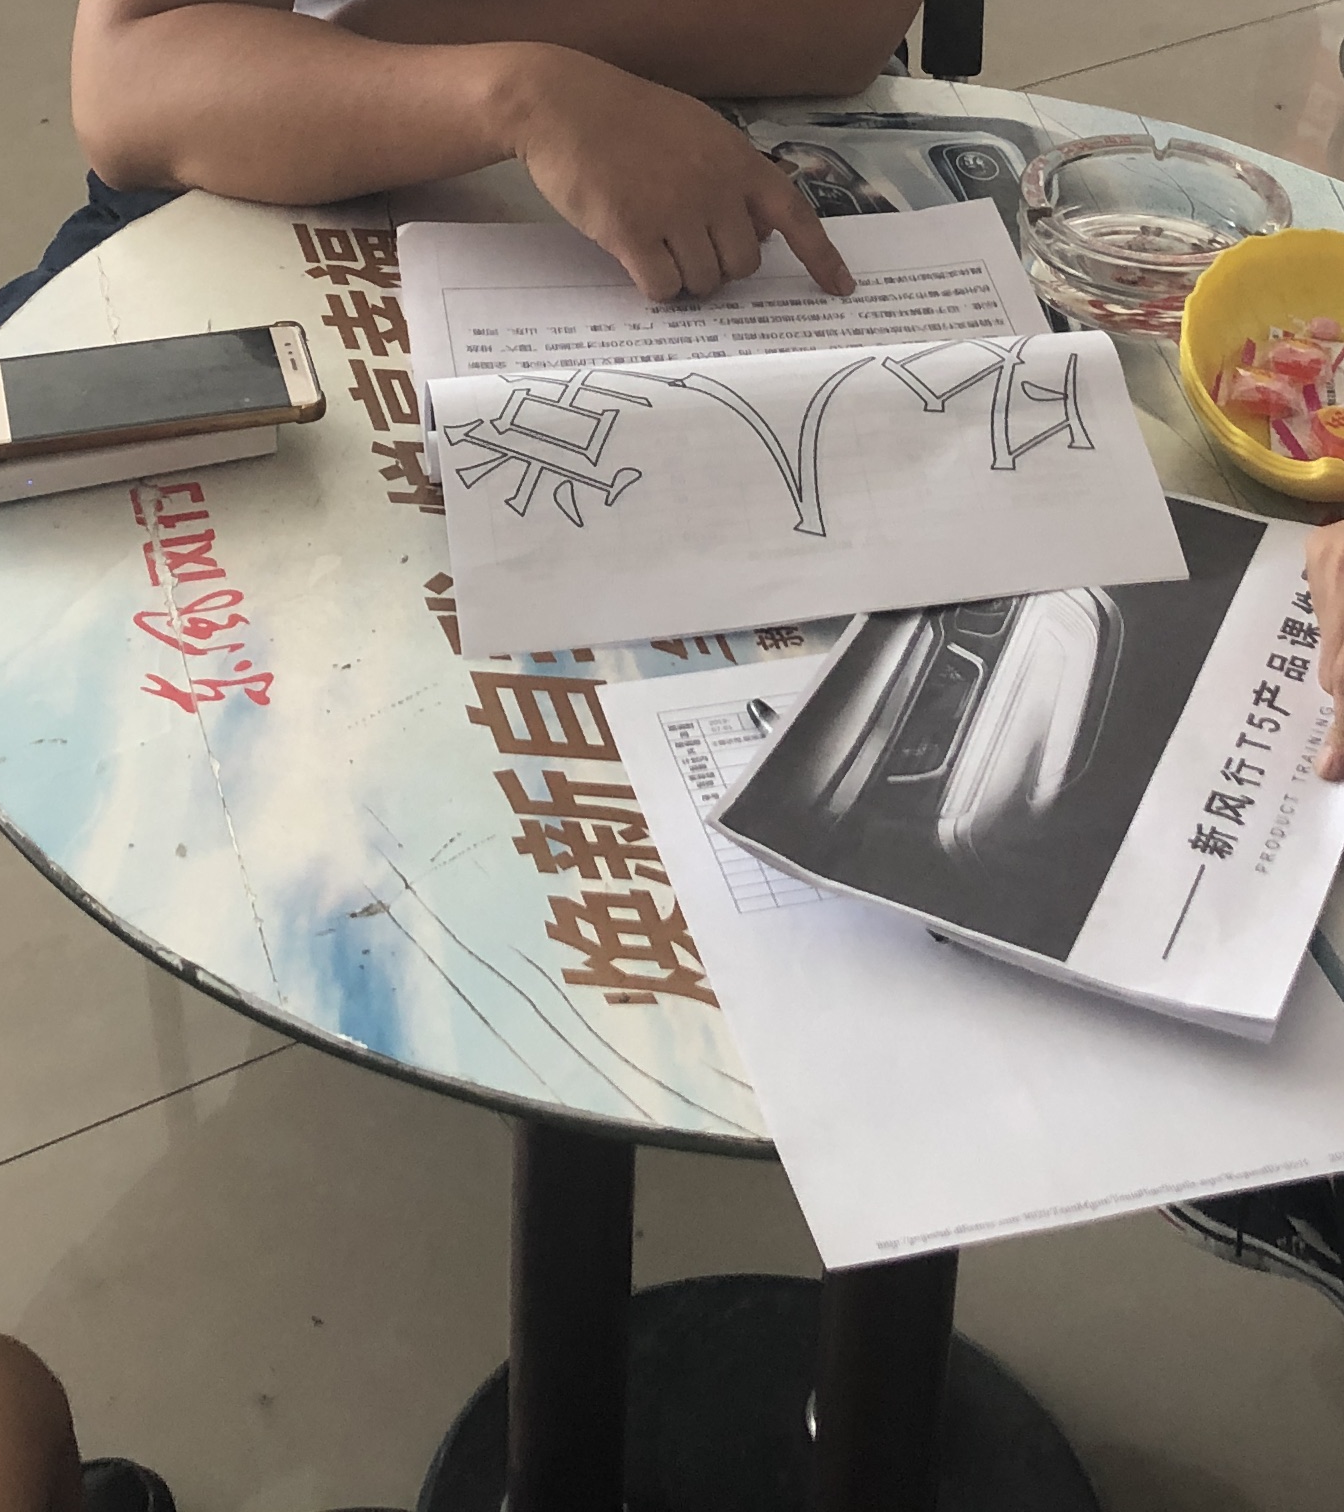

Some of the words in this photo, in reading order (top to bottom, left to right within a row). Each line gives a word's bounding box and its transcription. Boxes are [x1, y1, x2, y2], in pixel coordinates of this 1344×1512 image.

[1188, 569, 1322, 860] 新风行T5产品课件
[1255, 794, 1299, 875] PRODUCT
